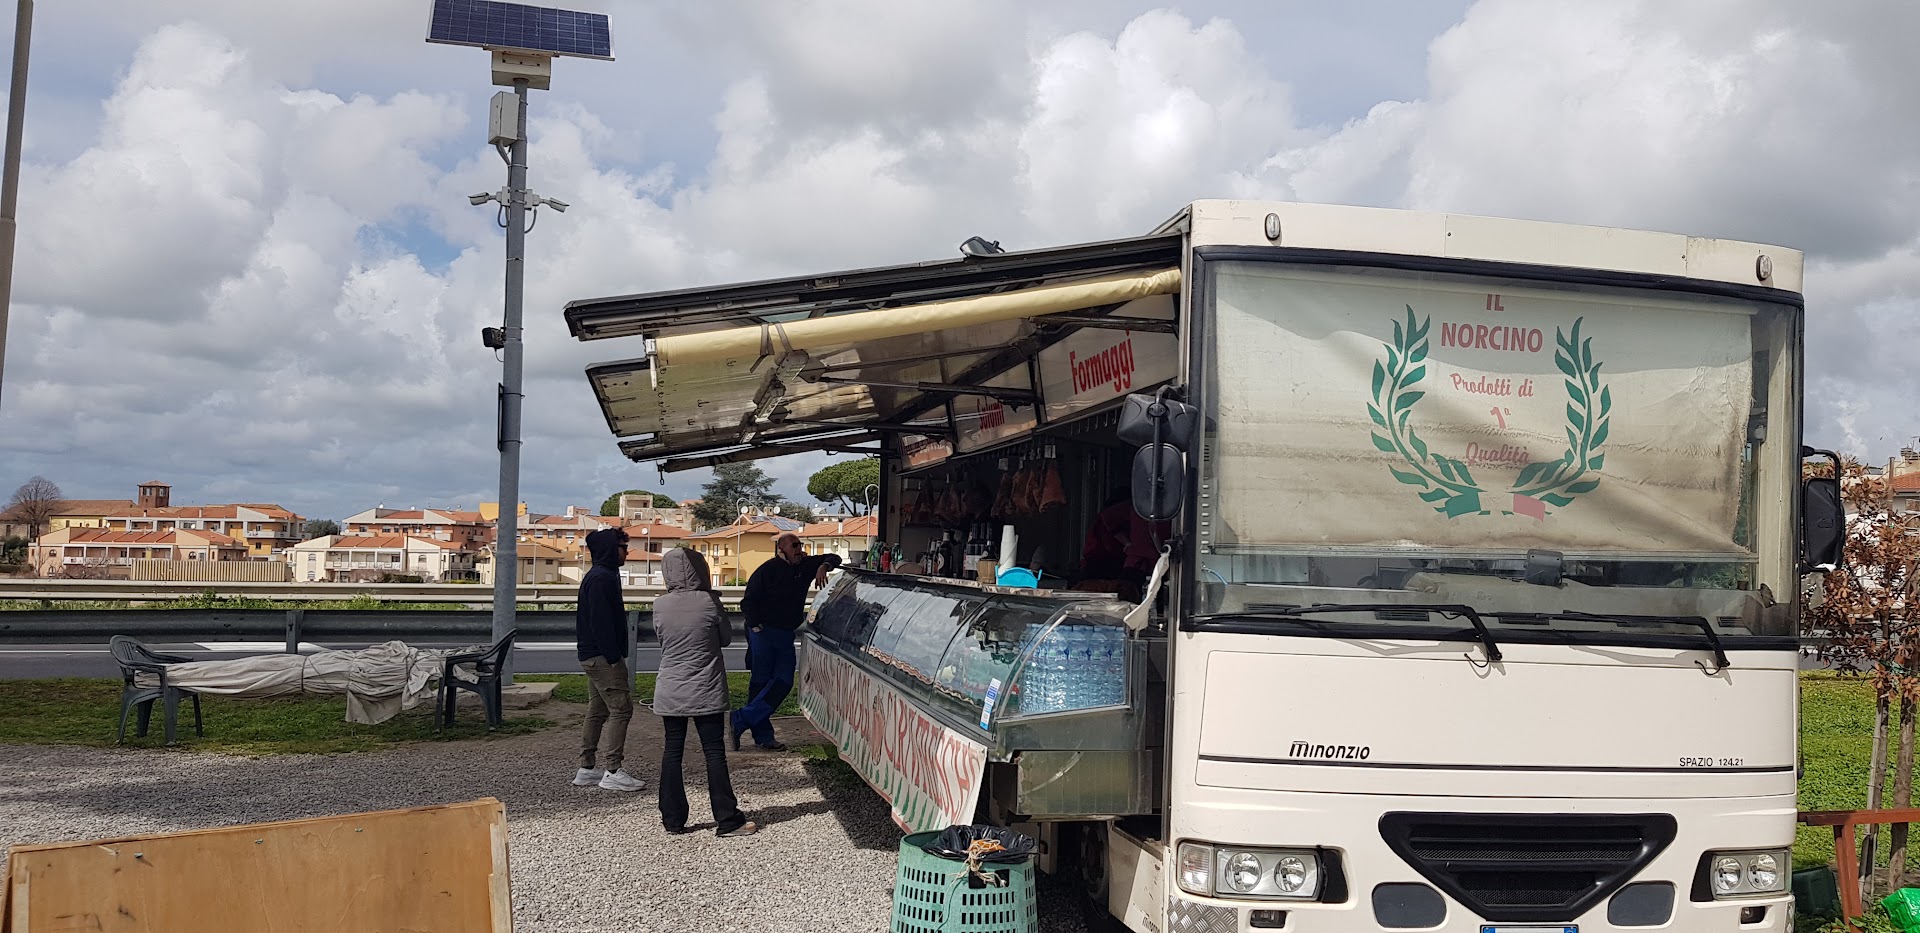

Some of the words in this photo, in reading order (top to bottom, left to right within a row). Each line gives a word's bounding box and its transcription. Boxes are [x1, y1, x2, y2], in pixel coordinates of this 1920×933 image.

[1486, 294, 1504, 311] IL
[1441, 322, 1543, 352] NORCINO
[1069, 327, 1135, 395] Formaggi
[1450, 373, 1511, 397] Prodotti
[1517, 379, 1534, 397] di
[1465, 441, 1529, 465] Qualità
[1679, 757, 1713, 767] SPAZIO
[1718, 757, 1744, 767] 124.21
